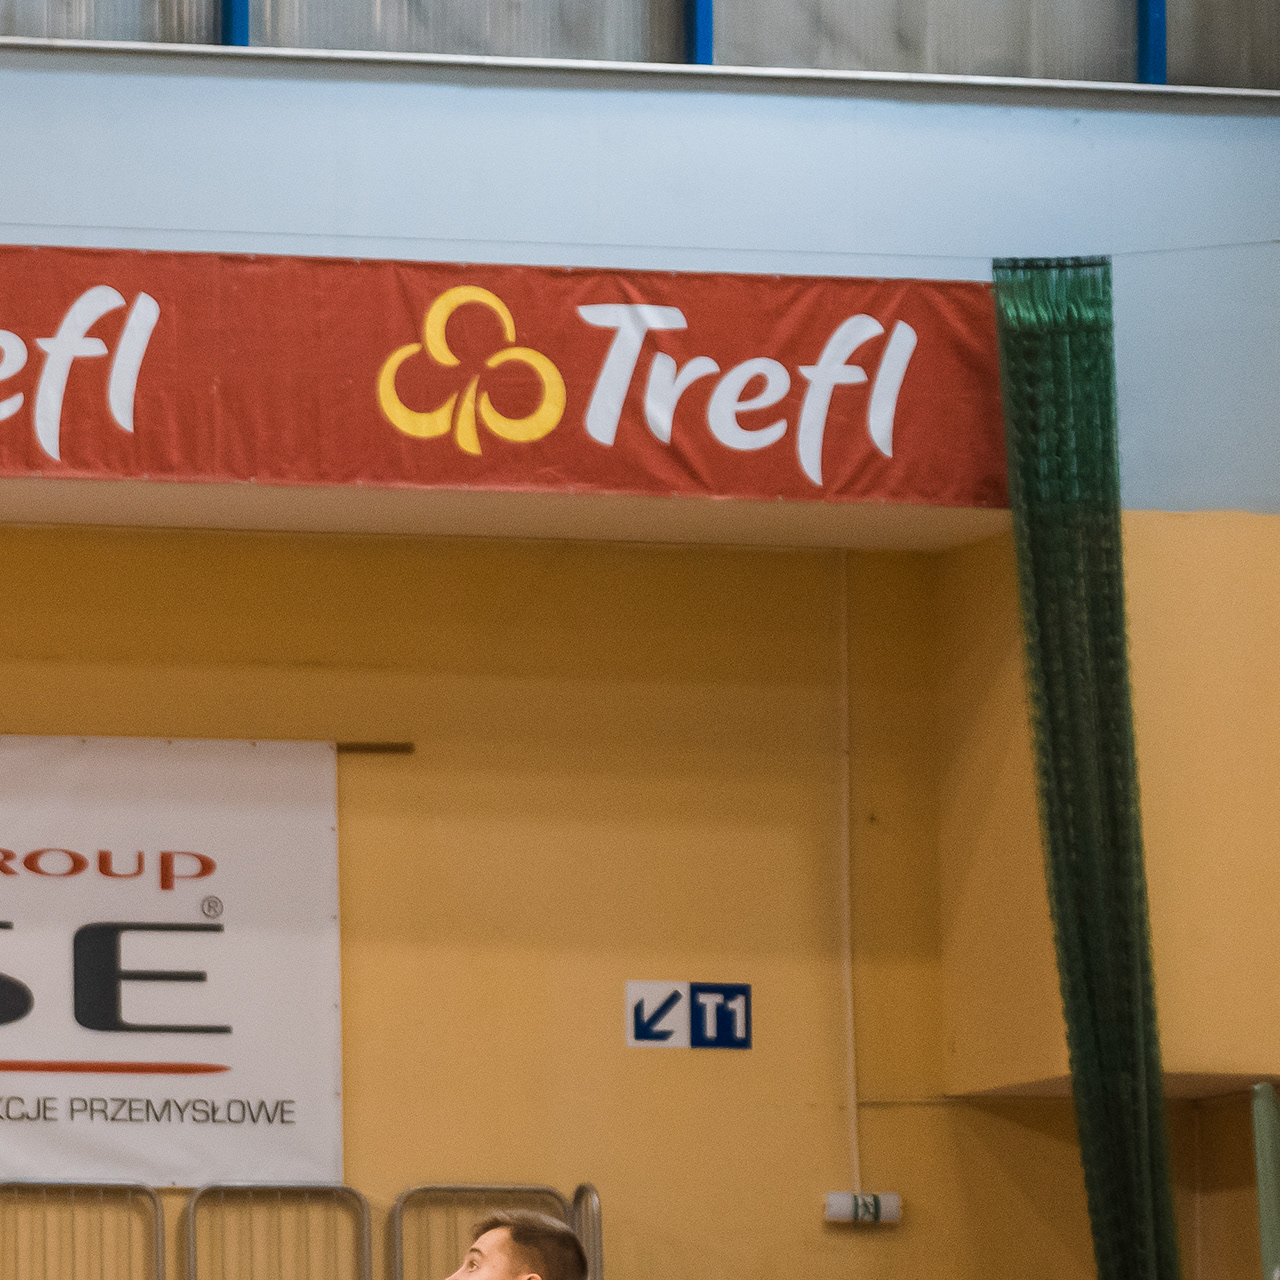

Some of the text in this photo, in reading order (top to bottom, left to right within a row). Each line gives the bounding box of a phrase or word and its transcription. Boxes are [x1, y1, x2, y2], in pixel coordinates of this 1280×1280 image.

[577, 303, 917, 486] Trefl
[698, 993, 746, 1040] T1
[69, 1096, 297, 1126] PRZEMYSŁOWE
